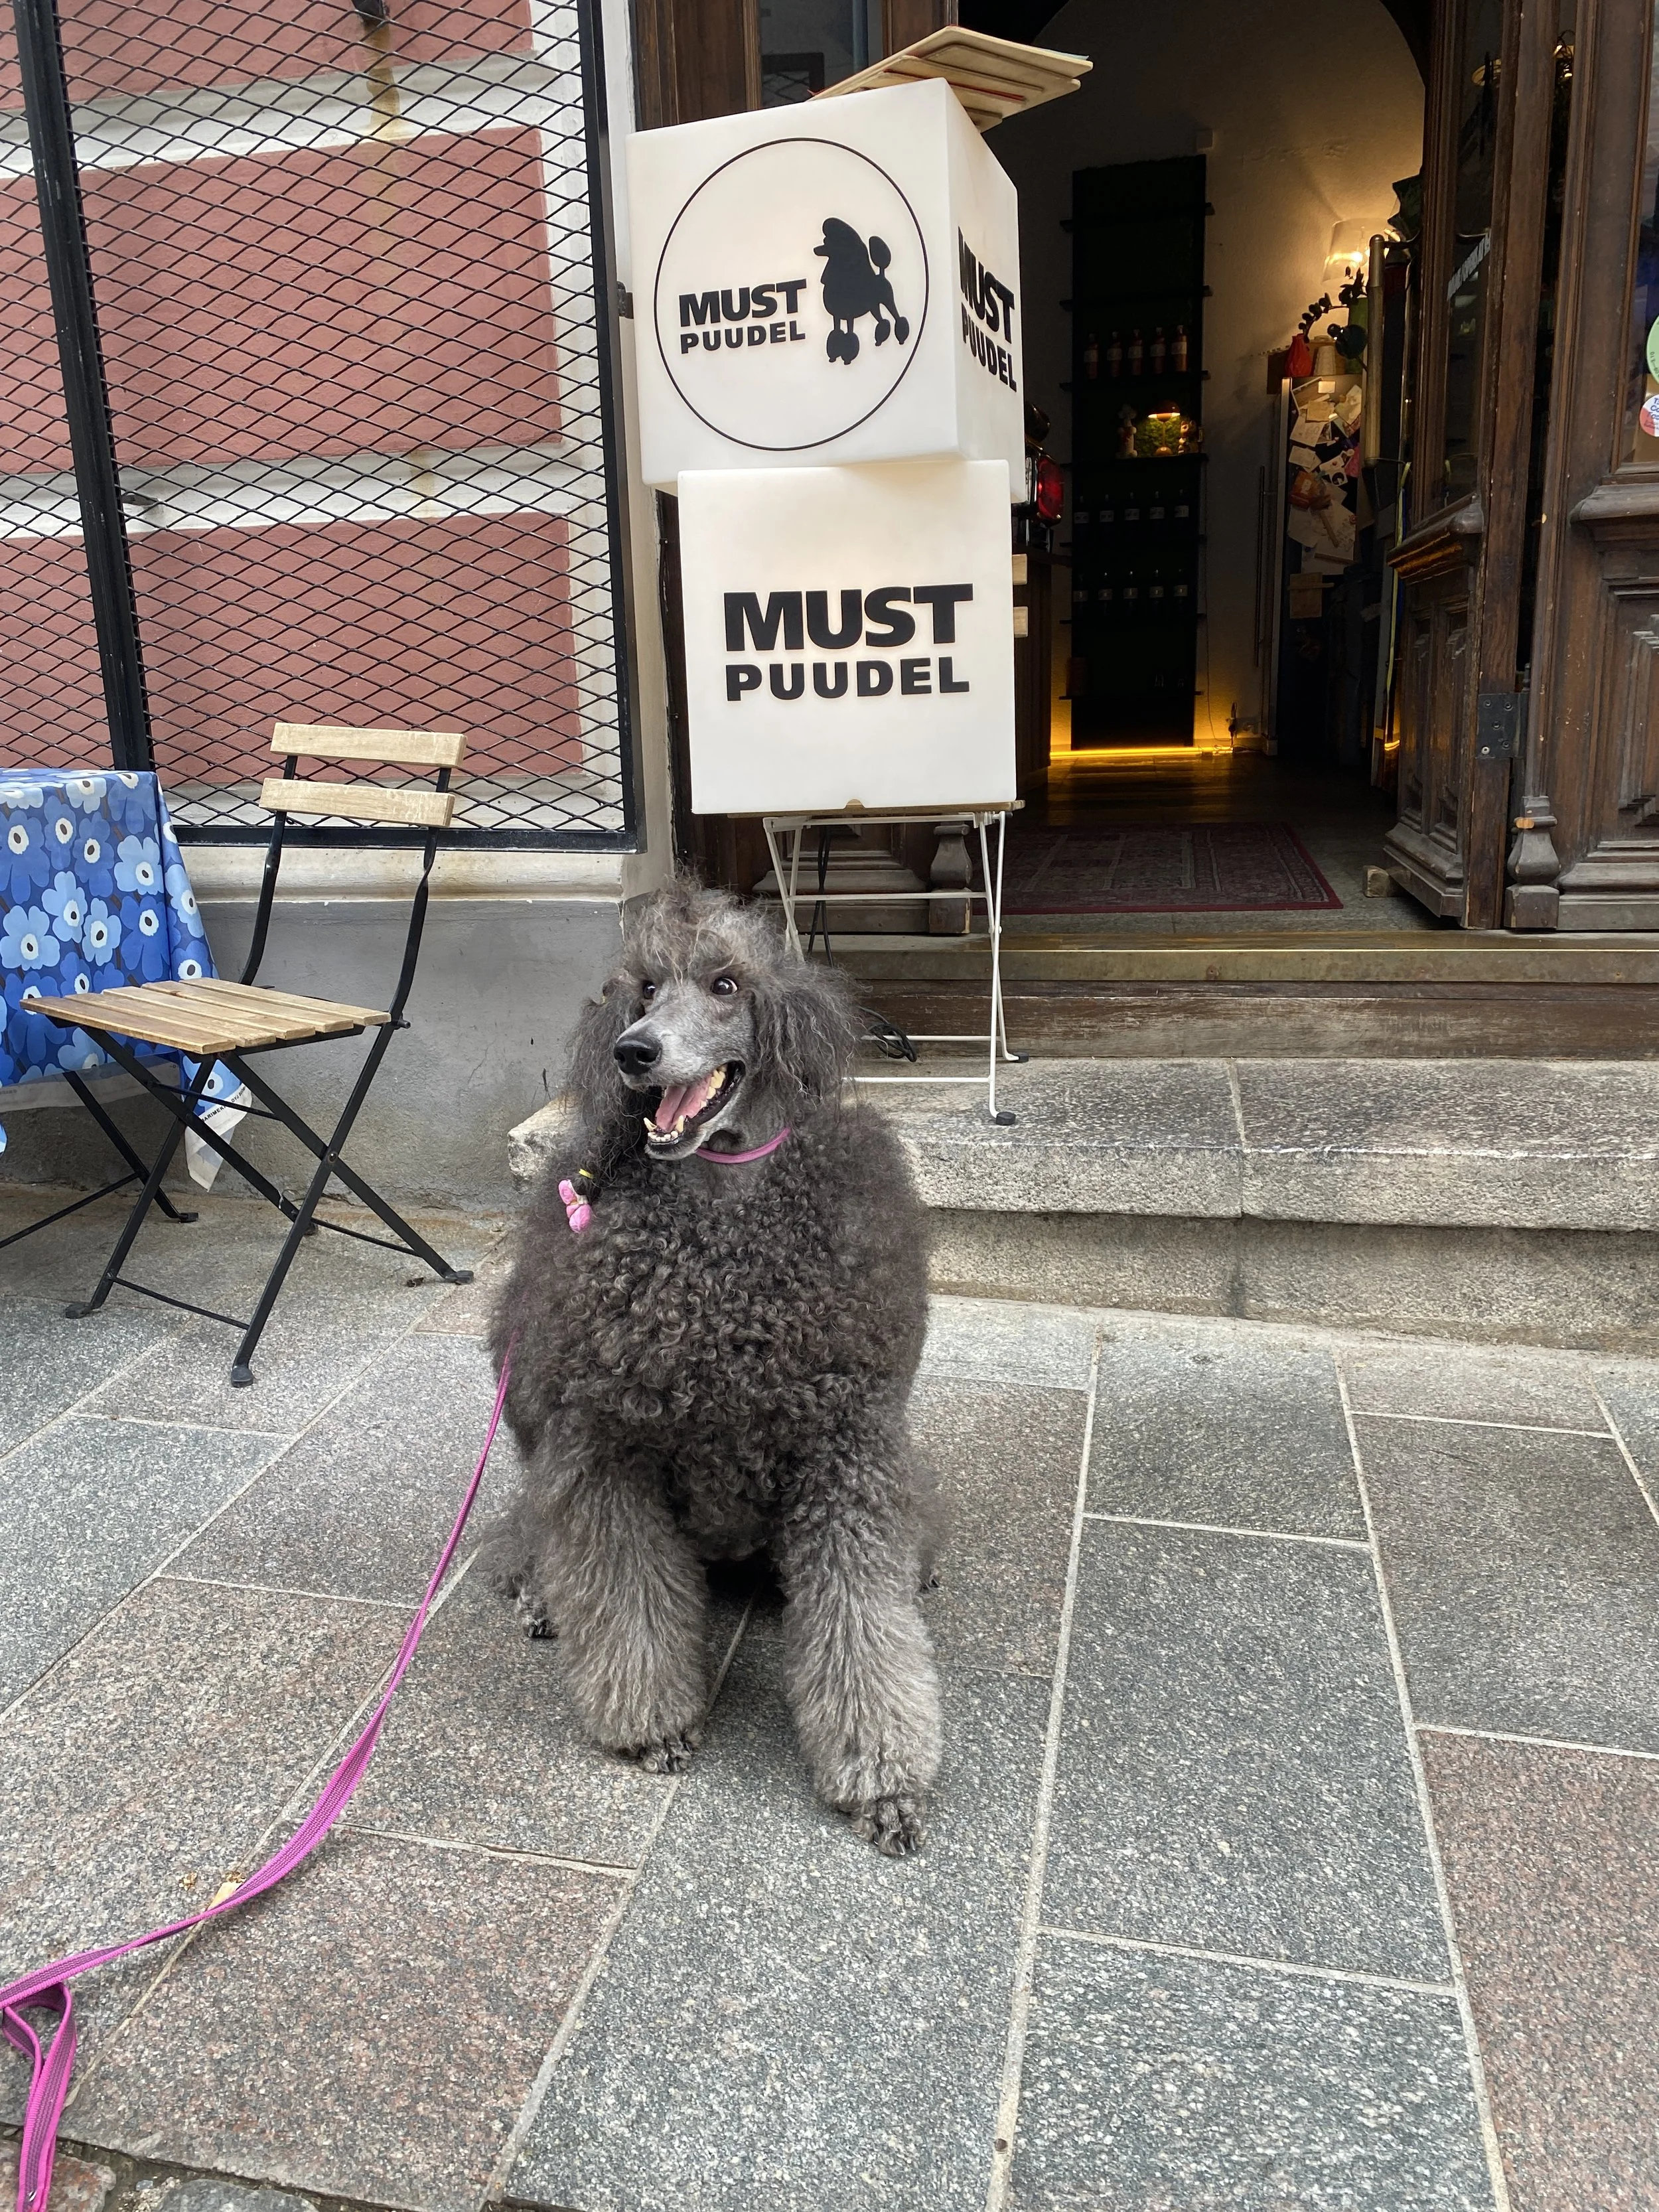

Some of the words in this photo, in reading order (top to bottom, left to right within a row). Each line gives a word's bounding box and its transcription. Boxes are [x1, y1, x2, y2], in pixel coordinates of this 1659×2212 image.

[679, 279, 807, 327] MUST
[958, 226, 1015, 344] MUST
[680, 320, 806, 354] PUUDEL
[961, 301, 1017, 393] PUUDEL
[723, 583, 974, 652] MUST
[725, 656, 970, 701] PUUDEL
